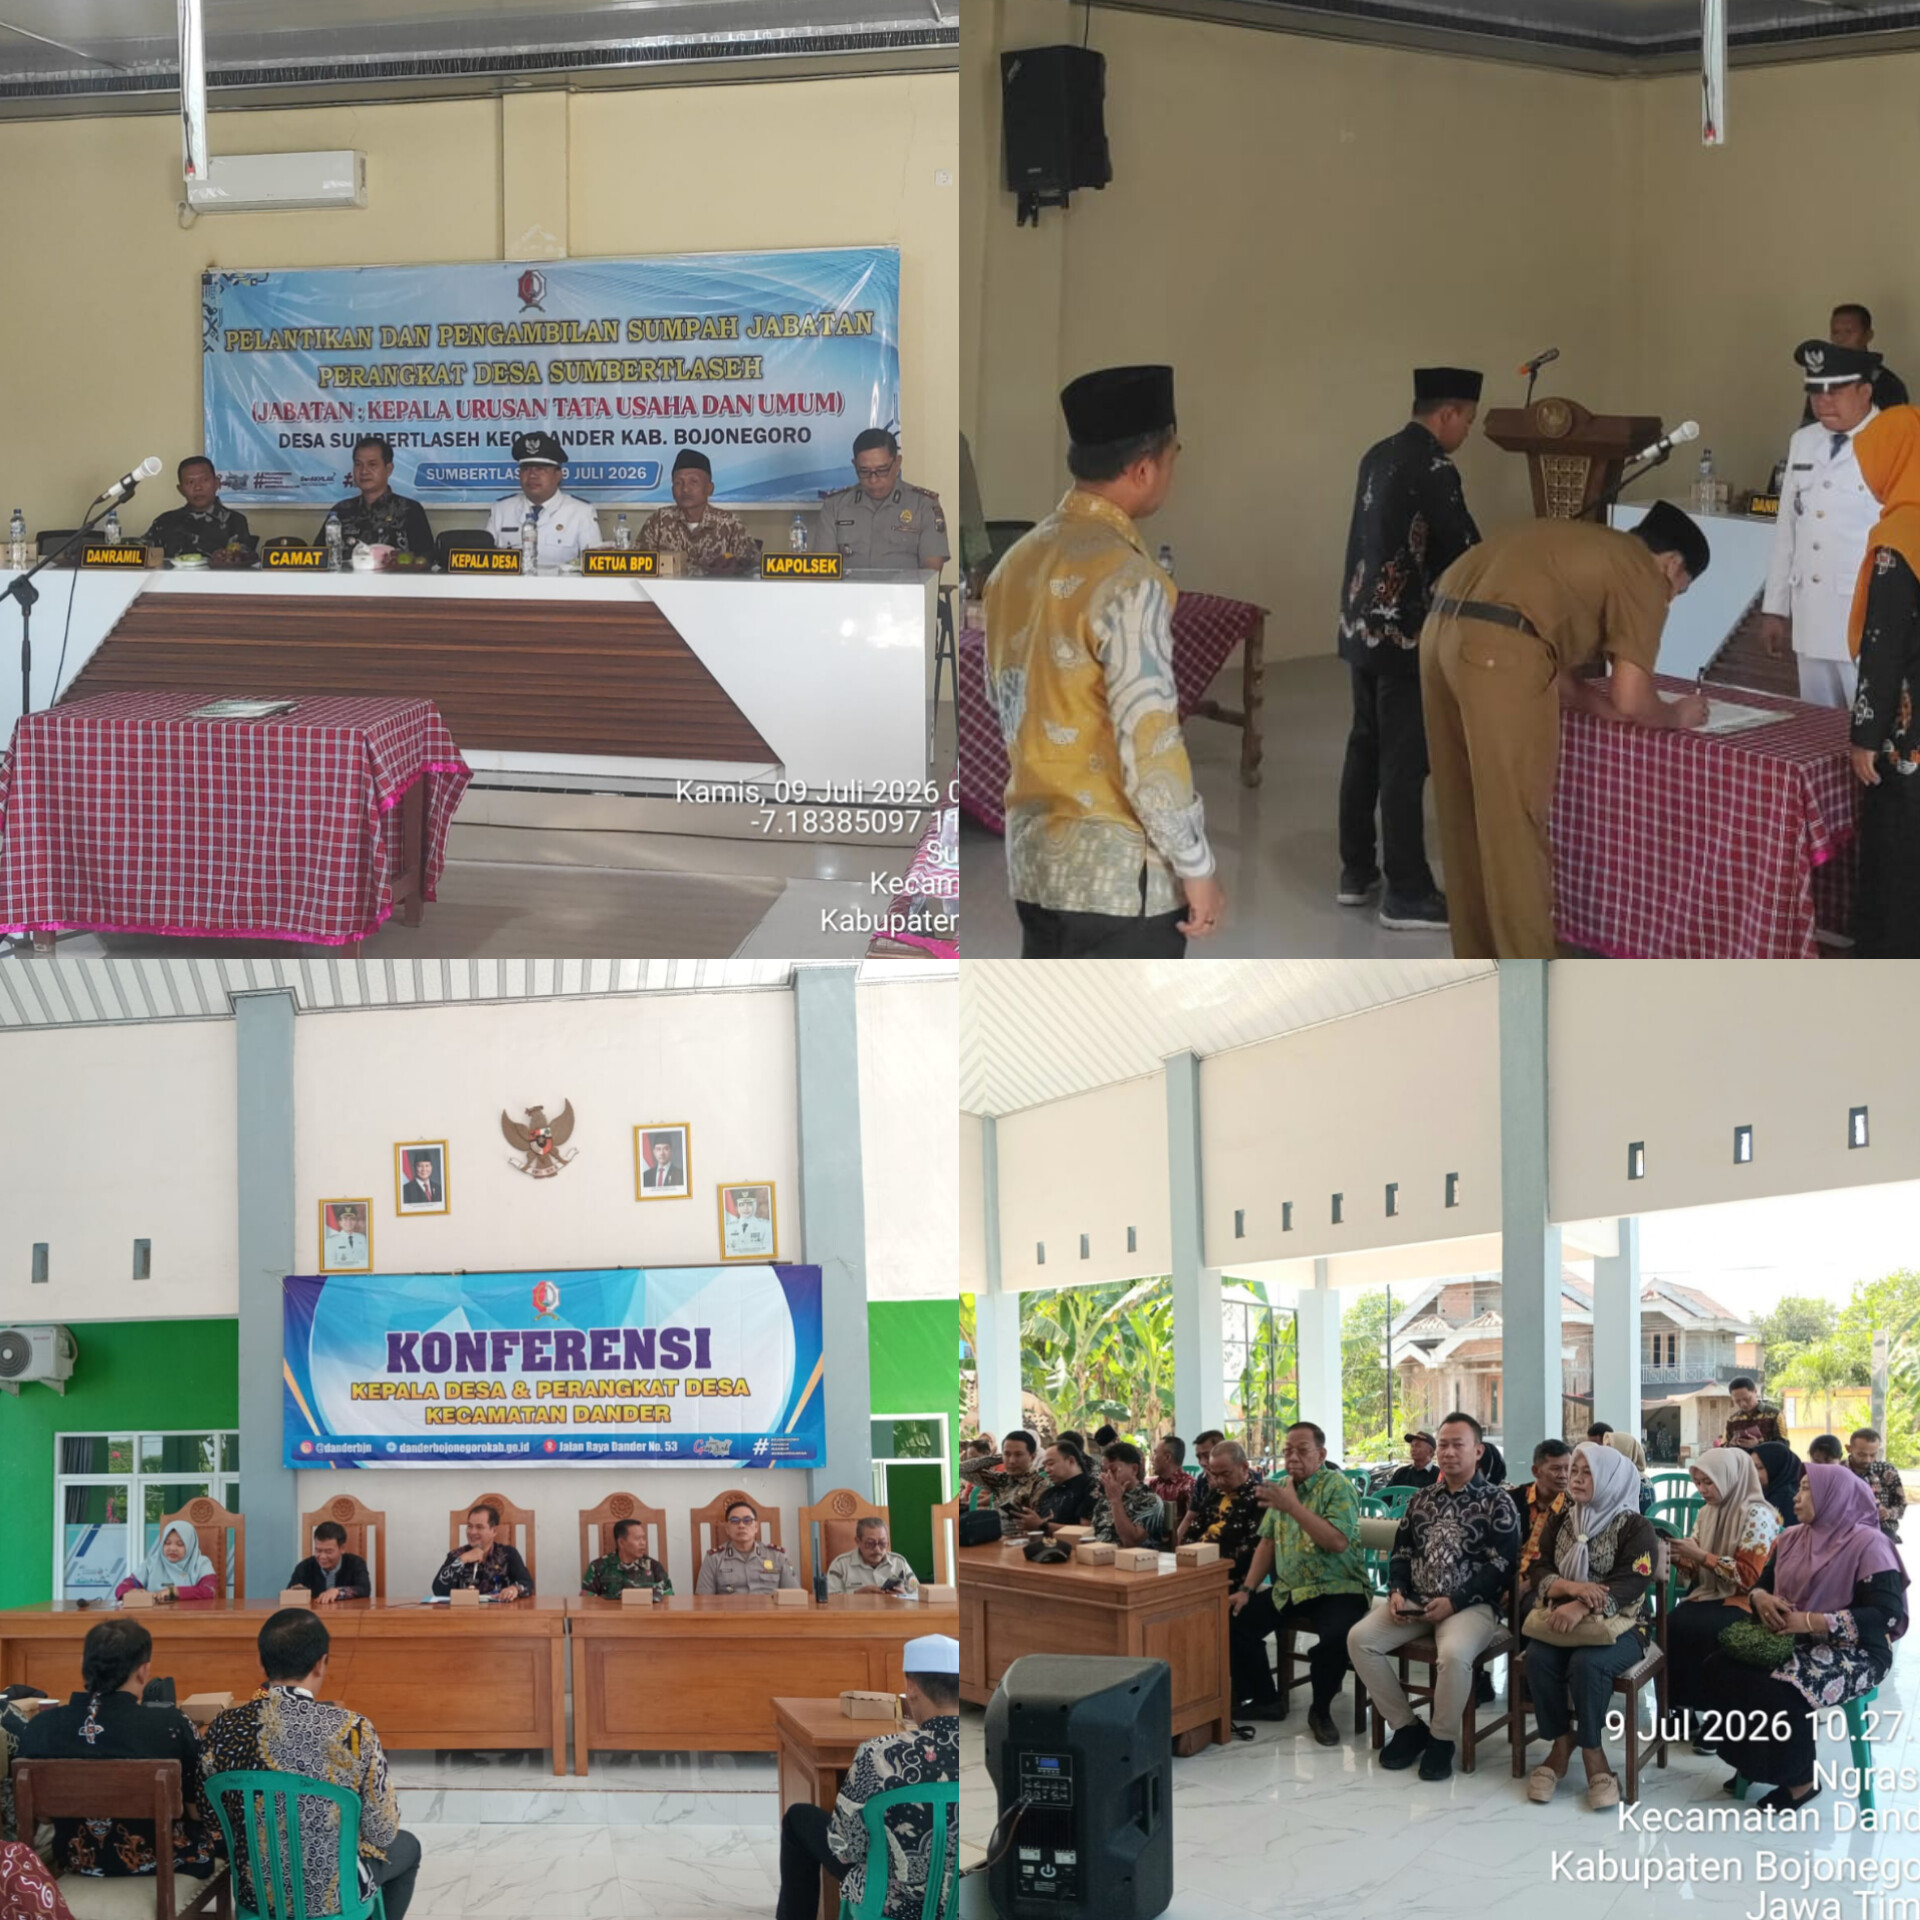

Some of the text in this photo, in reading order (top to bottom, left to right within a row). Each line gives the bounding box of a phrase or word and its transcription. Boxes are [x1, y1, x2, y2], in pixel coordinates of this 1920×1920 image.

[225, 311, 875, 352] PELANTIKAN DAN PENGAMBILAN SUMPAH JABATAN
[318, 356, 763, 388] PERANGKAT DESA SUMBERTLASEH
[252, 400, 355, 425] (JABATAN
[368, 399, 454, 421] KEPALA
[456, 397, 547, 420] URUSAN
[553, 396, 611, 418] TATA
[616, 395, 697, 417] USAHA
[702, 394, 755, 416] DAN
[758, 391, 845, 415] UMUM)
[279, 432, 325, 449] DESA
[535, 430, 614, 446] ANDER
[621, 430, 667, 446] KAB.
[674, 427, 812, 446] BOJONEGORO
[574, 467, 604, 481] JULI
[608, 466, 647, 480] 2026
[86, 550, 142, 564] DANRAMIL
[269, 551, 323, 566] CAMAT
[451, 553, 518, 569] KEPALA DESA
[588, 555, 653, 571] KETUA BPD
[766, 557, 838, 574] KAPOLSEK
[385, 1327, 712, 1374] KONFERENSI
[351, 1378, 751, 1400] KEPALA DESA & PERANGKAT DESA
[425, 1404, 671, 1425] KECAMATAN DANDER
[315, 1441, 372, 1454] @danderbjn
[399, 1440, 530, 1455] danderbojonegorokab.go.id
[559, 1440, 678, 1454] Jalan Raya Dander No. 53
